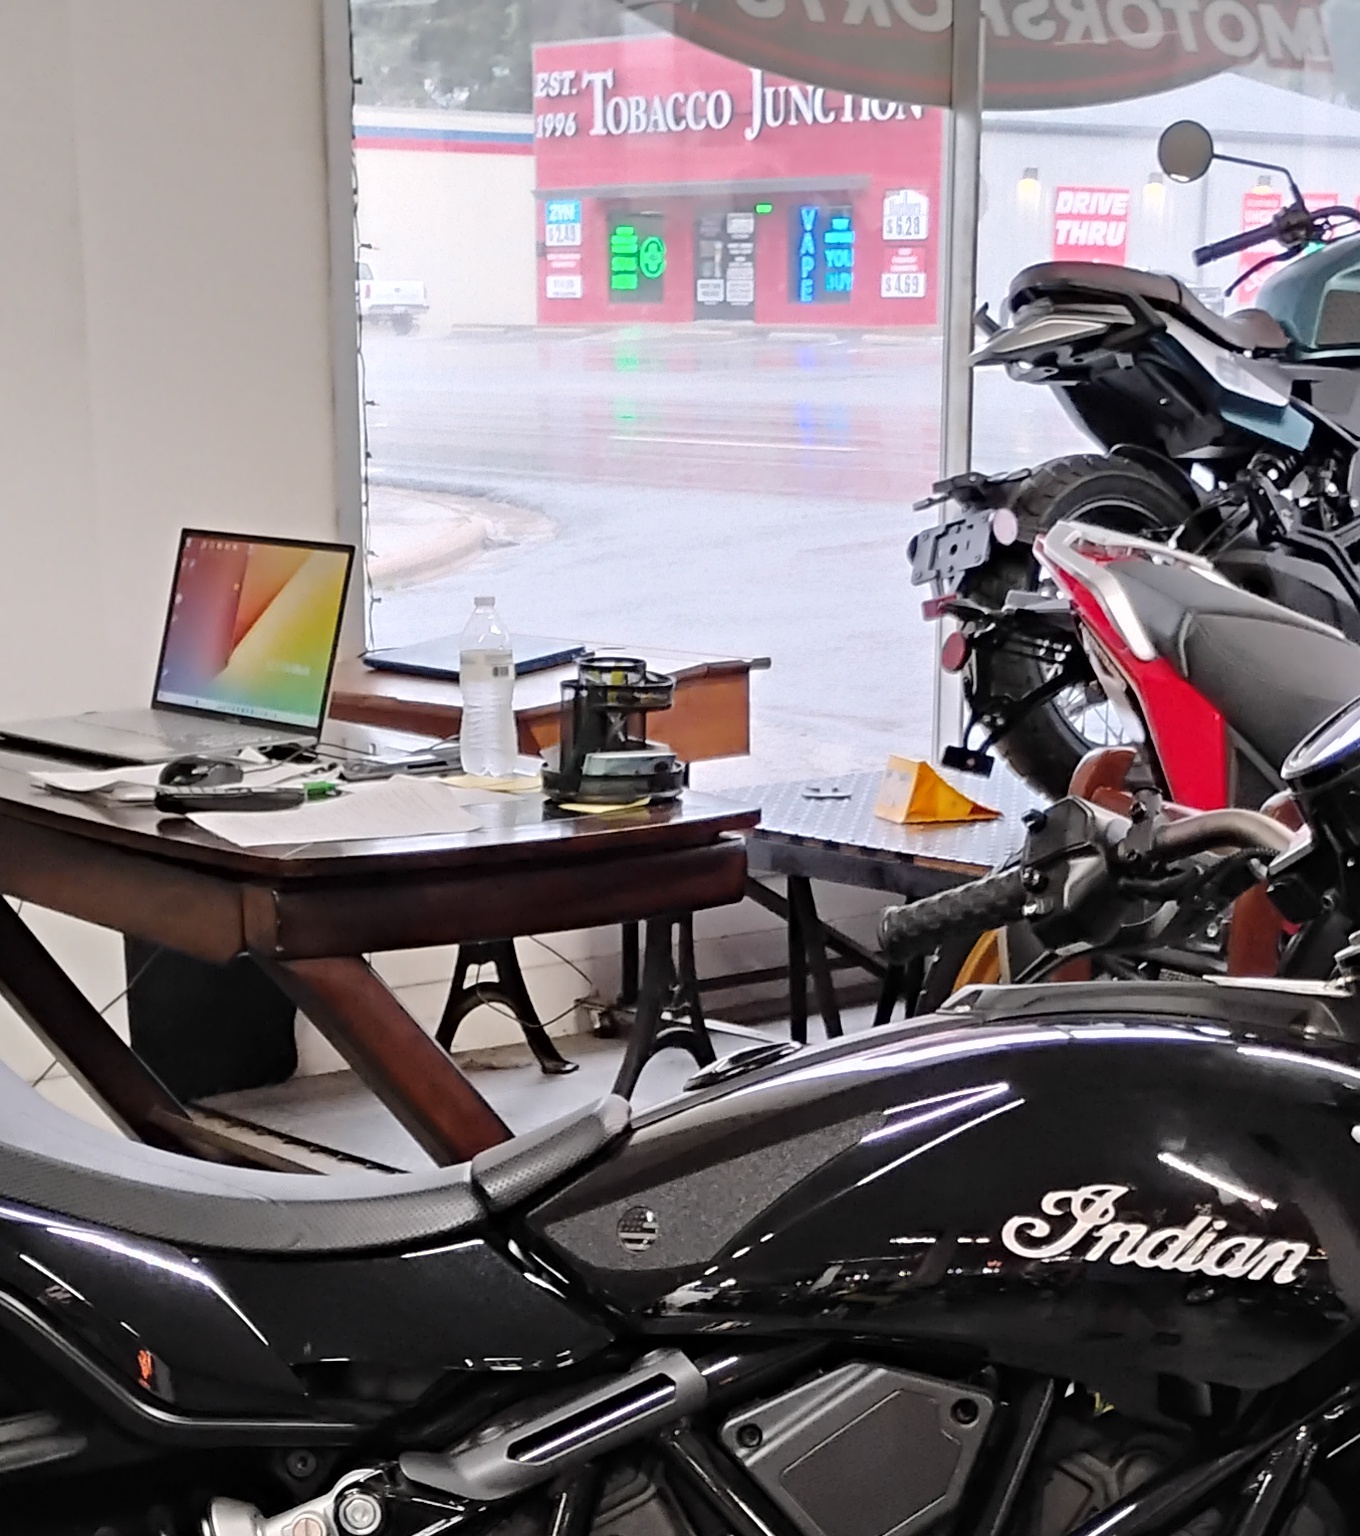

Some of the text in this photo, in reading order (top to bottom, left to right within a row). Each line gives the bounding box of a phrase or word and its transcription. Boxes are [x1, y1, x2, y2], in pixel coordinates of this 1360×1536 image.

[535, 70, 577, 98] EST.
[581, 68, 731, 137] TOBACCO
[535, 112, 577, 138] 1996
[1056, 191, 1127, 216] DRIVE
[1055, 219, 1125, 247] THRU
[1001, 1183, 1312, 1285] Indian
